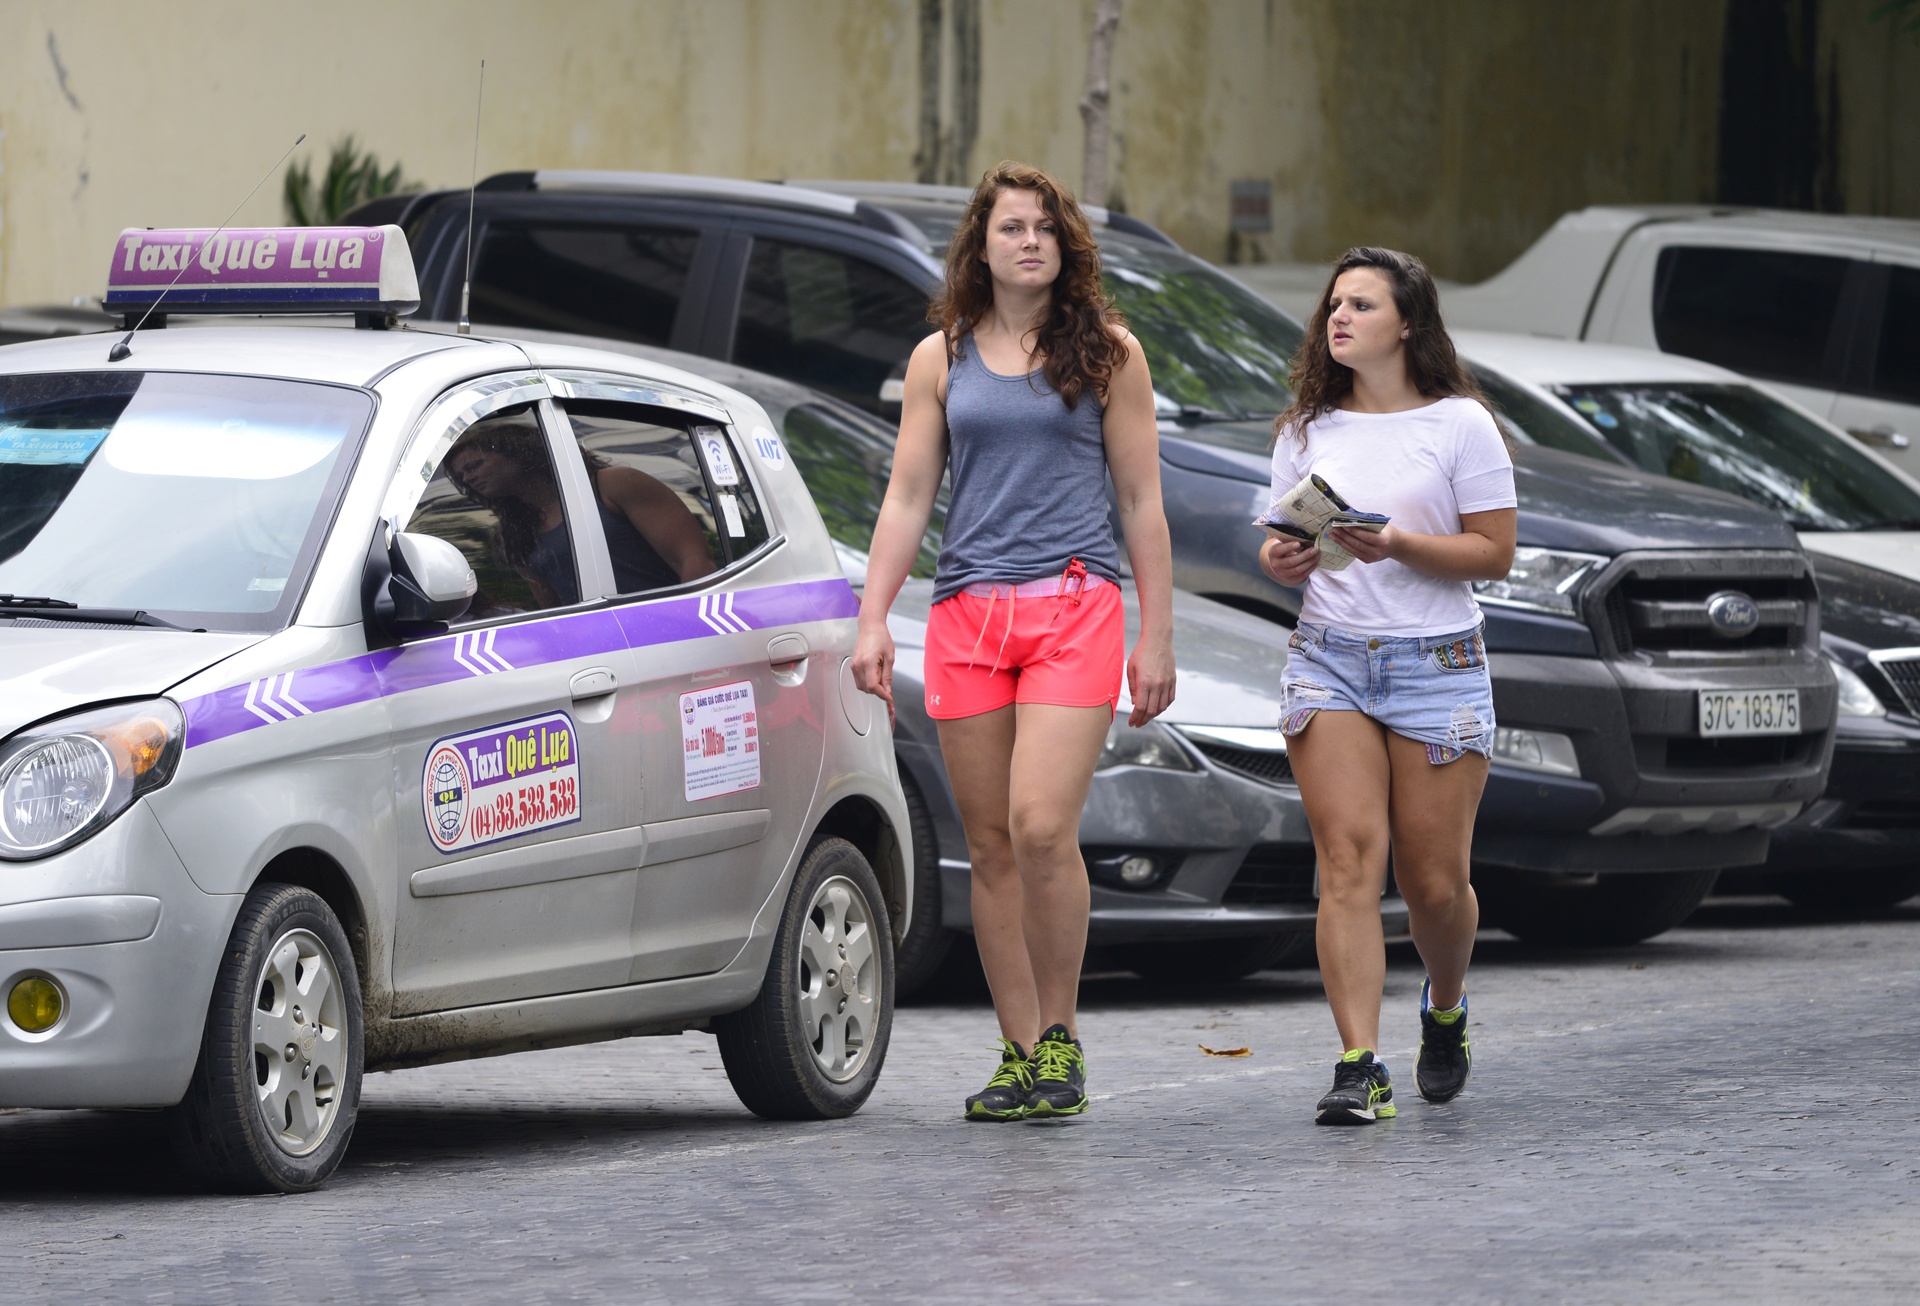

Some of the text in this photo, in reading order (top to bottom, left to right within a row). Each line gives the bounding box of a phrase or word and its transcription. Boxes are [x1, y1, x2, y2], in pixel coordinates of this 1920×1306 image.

[123, 230, 366, 278] Taxi Quê Lụa
[754, 437, 782, 461] 107
[1725, 601, 1751, 624] Ford
[468, 727, 569, 782] Taxi Quê Lụa
[439, 790, 458, 804] QL
[470, 776, 576, 843] (04)33.533.533
